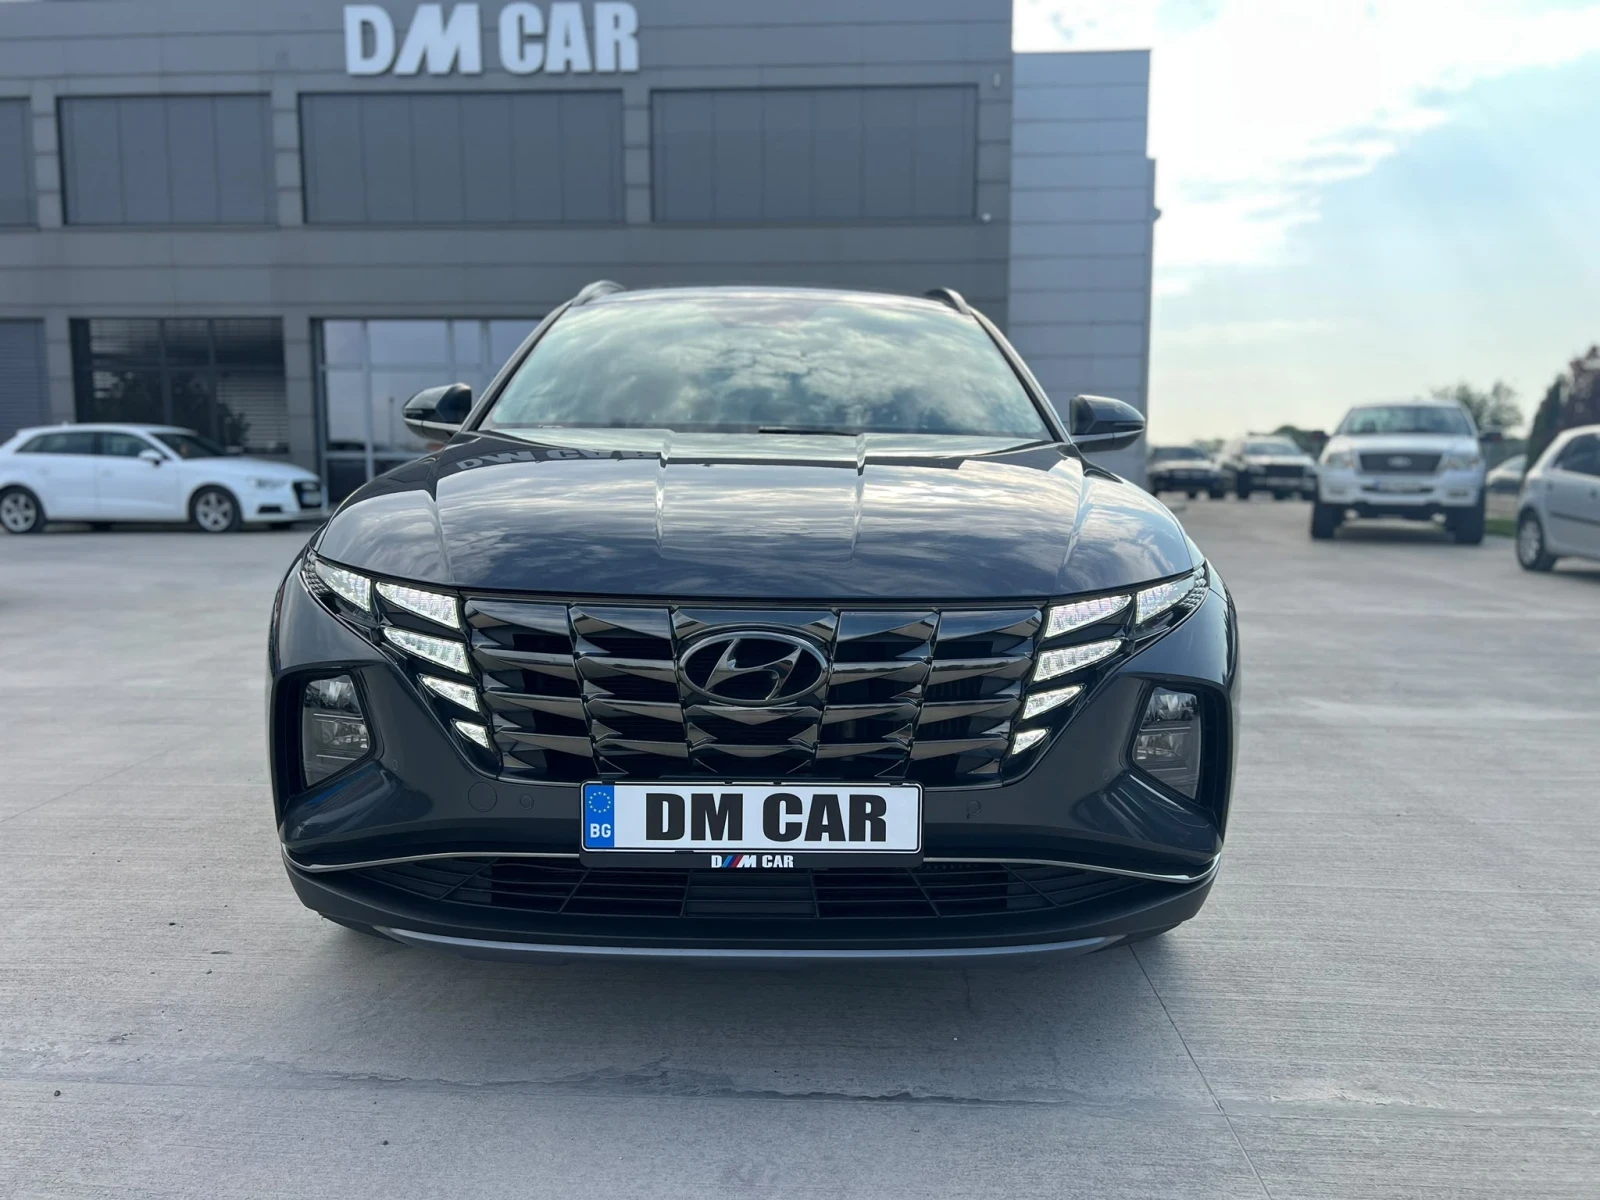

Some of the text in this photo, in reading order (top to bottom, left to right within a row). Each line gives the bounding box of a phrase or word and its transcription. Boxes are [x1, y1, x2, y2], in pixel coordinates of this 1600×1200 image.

[344, 0, 639, 75] DM CAR
[590, 824, 611, 838] BG
[645, 793, 887, 842] DM CAR
[761, 854, 794, 868] CAR
